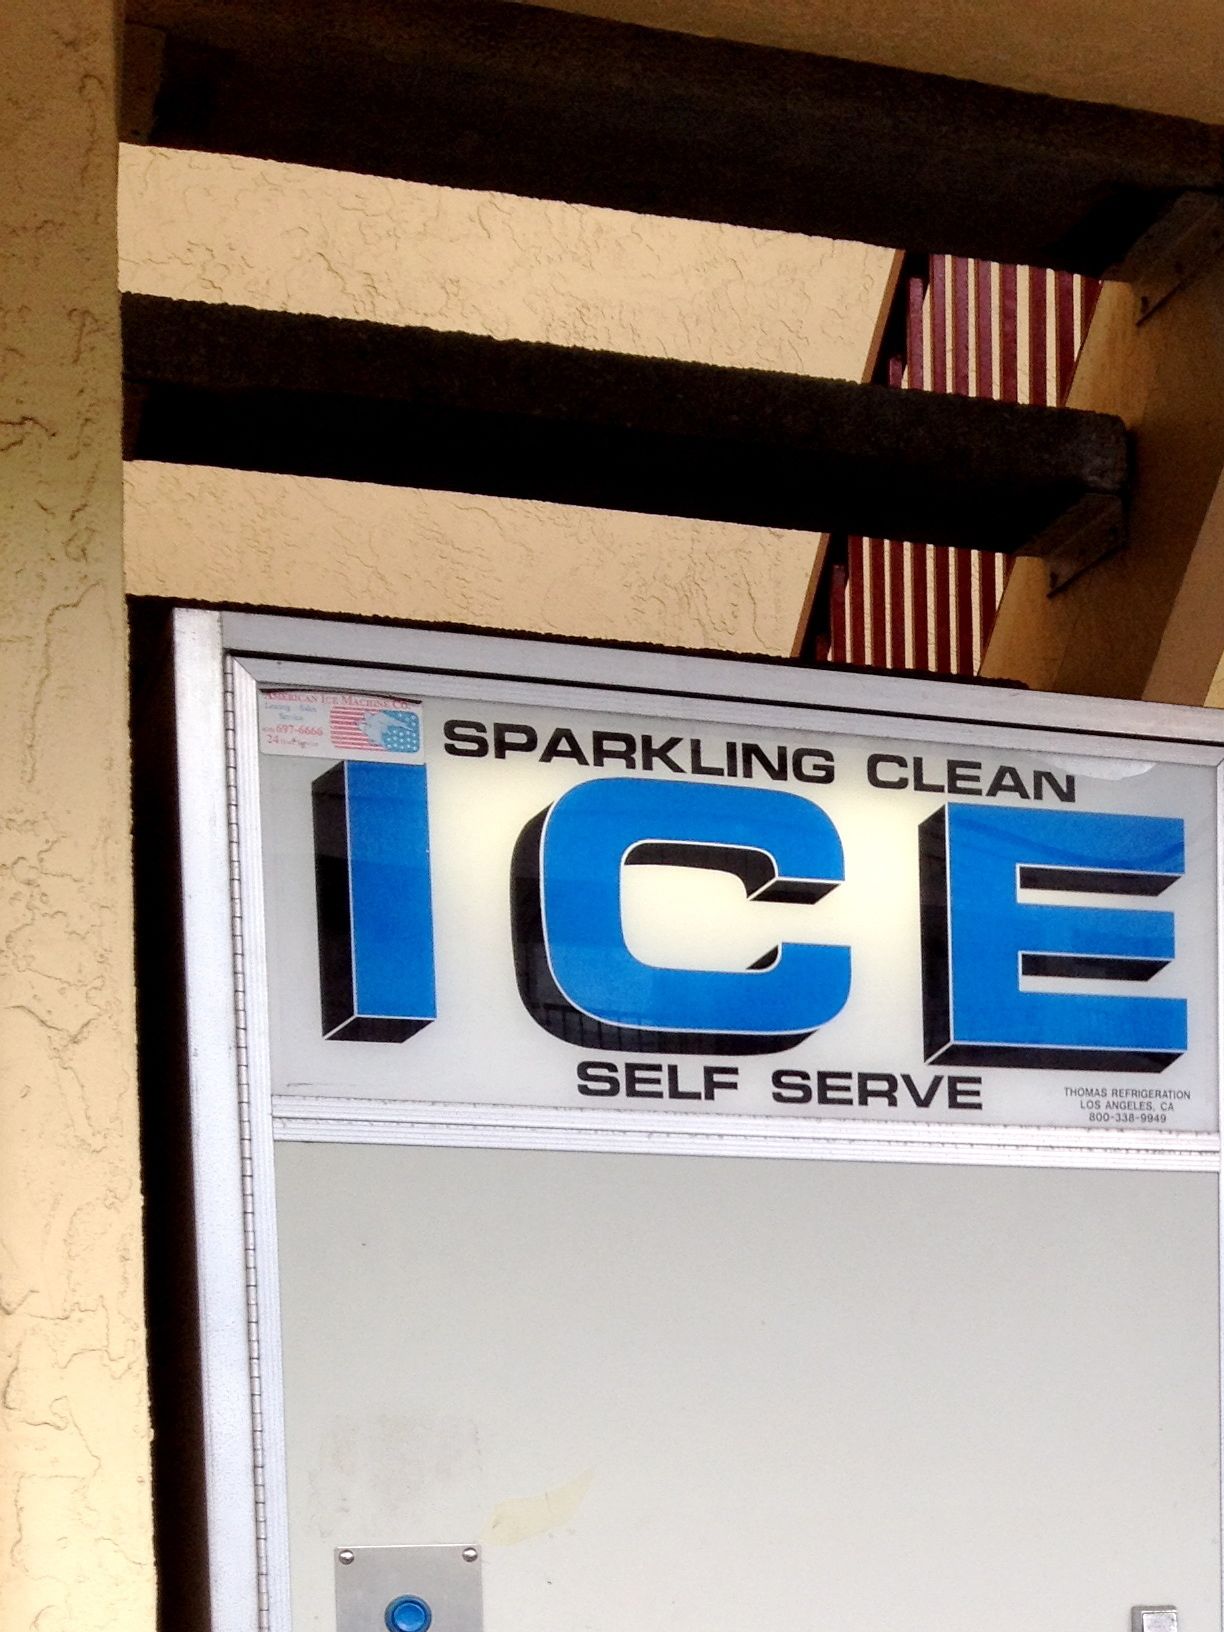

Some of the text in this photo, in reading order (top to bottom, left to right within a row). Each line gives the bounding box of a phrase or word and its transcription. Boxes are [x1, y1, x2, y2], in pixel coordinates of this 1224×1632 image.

[443, 719, 1076, 803] SPARKLING CLEAN
[311, 757, 1189, 1076] ICE
[576, 1060, 983, 1111] SELF SERVE
[1063, 1086, 1191, 1100] THOMAS REFRIGERATION
[1080, 1099, 1101, 1110] LOS
[1160, 1102, 1175, 1112] CA
